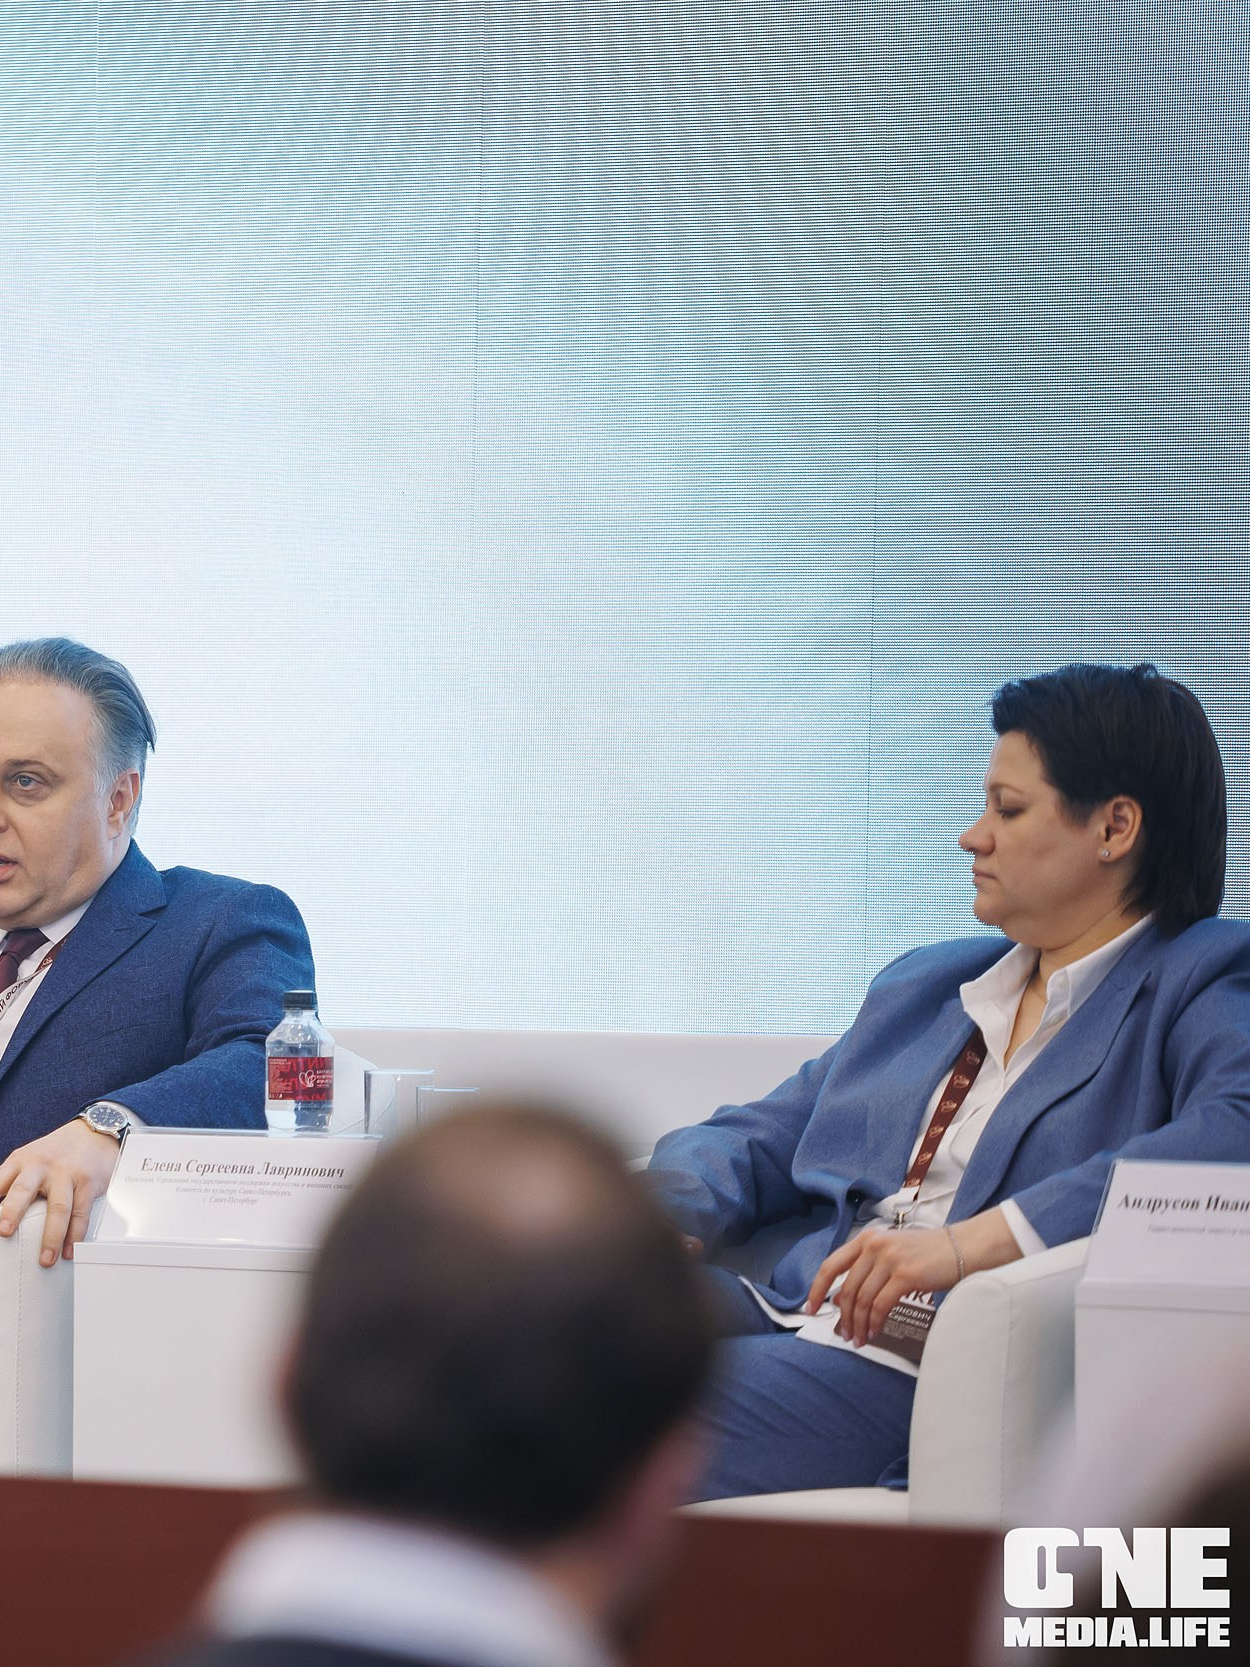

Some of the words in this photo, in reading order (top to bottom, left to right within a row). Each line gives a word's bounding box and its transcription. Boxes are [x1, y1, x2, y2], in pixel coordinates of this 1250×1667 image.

[140, 1158, 182, 1172] Елена
[186, 1159, 255, 1177] Сергеевна
[257, 1162, 345, 1179] Лавринович
[1117, 1194, 1200, 1215] Андрусов
